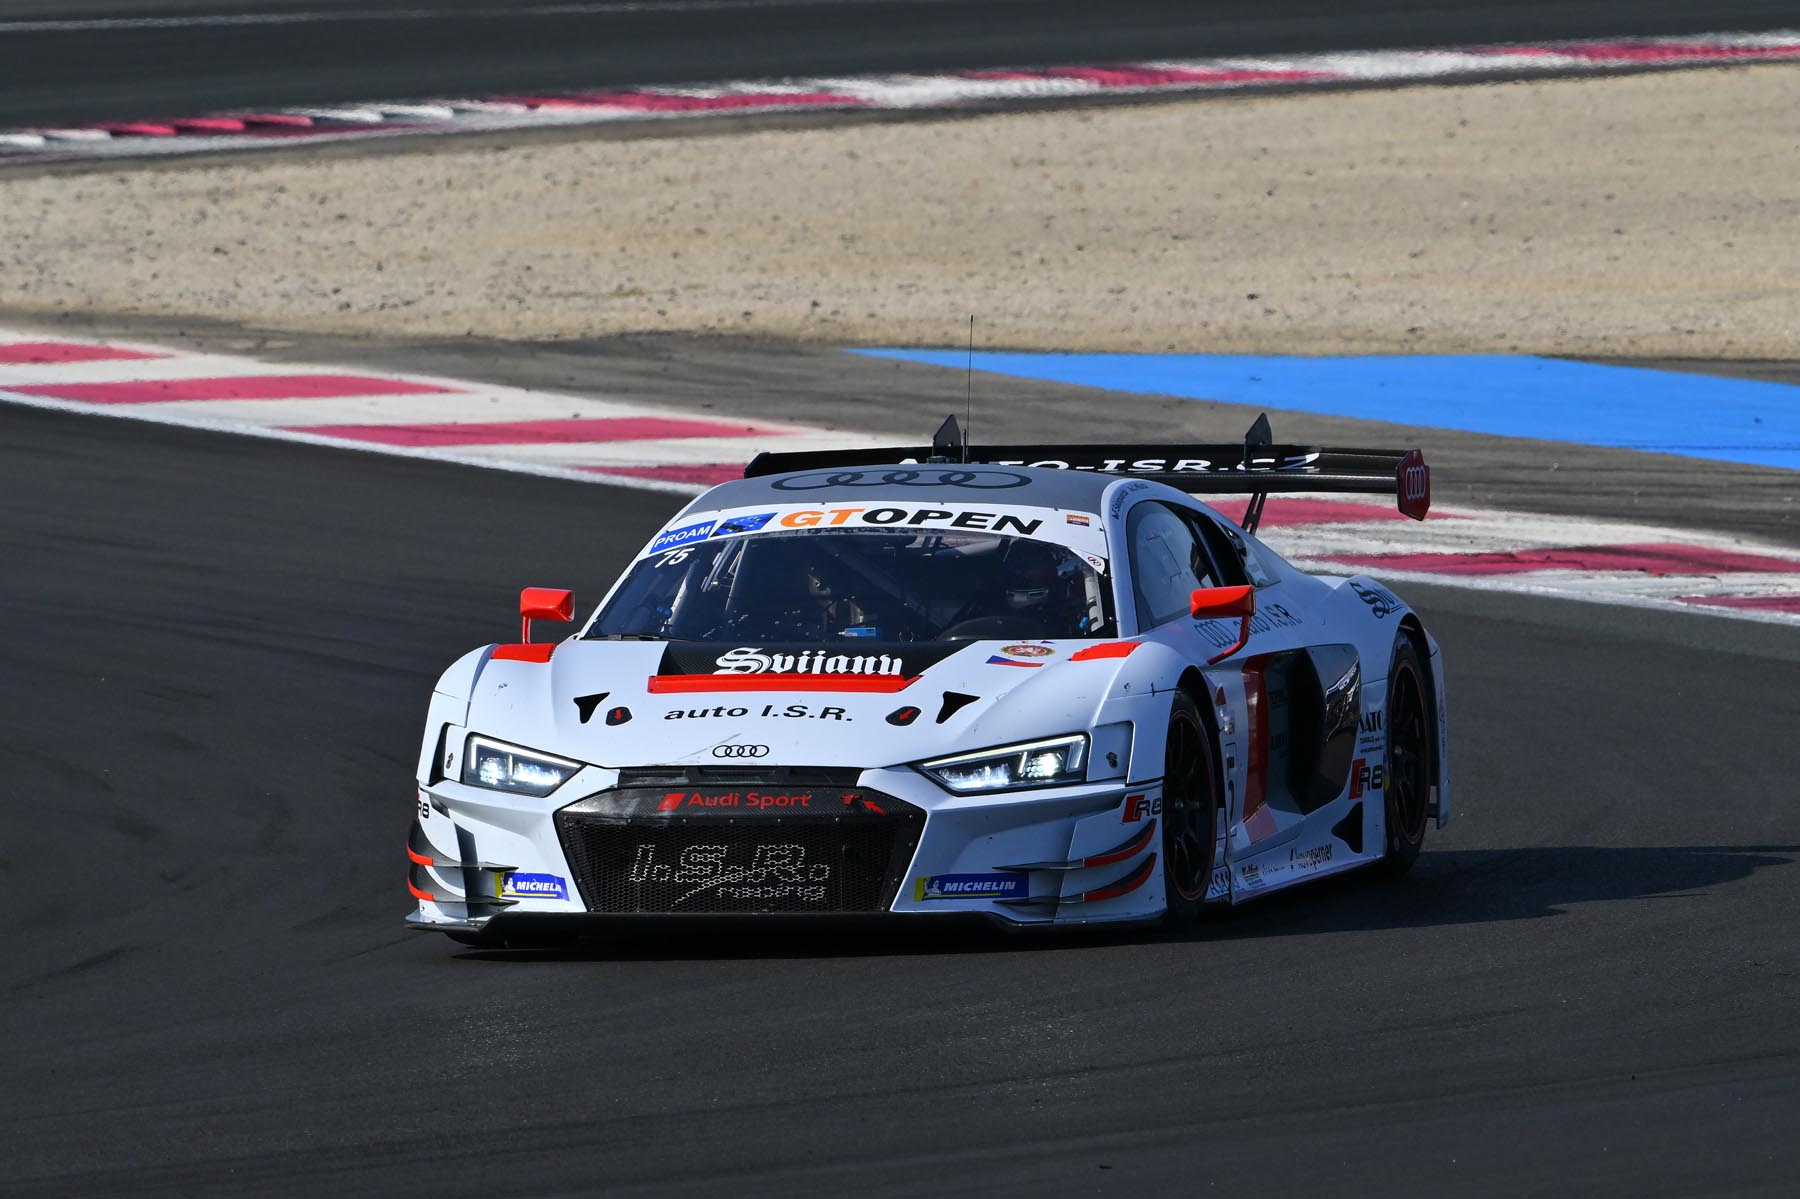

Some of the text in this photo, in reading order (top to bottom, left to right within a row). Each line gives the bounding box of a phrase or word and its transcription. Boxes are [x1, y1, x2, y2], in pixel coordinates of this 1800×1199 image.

[654, 525, 712, 548] PROAM
[655, 547, 695, 568] 75
[664, 704, 853, 722] auto I.S.R.
[1360, 765, 1383, 791] R8
[687, 792, 810, 809] Audi Sport
[943, 881, 1016, 892] MICHELIN
